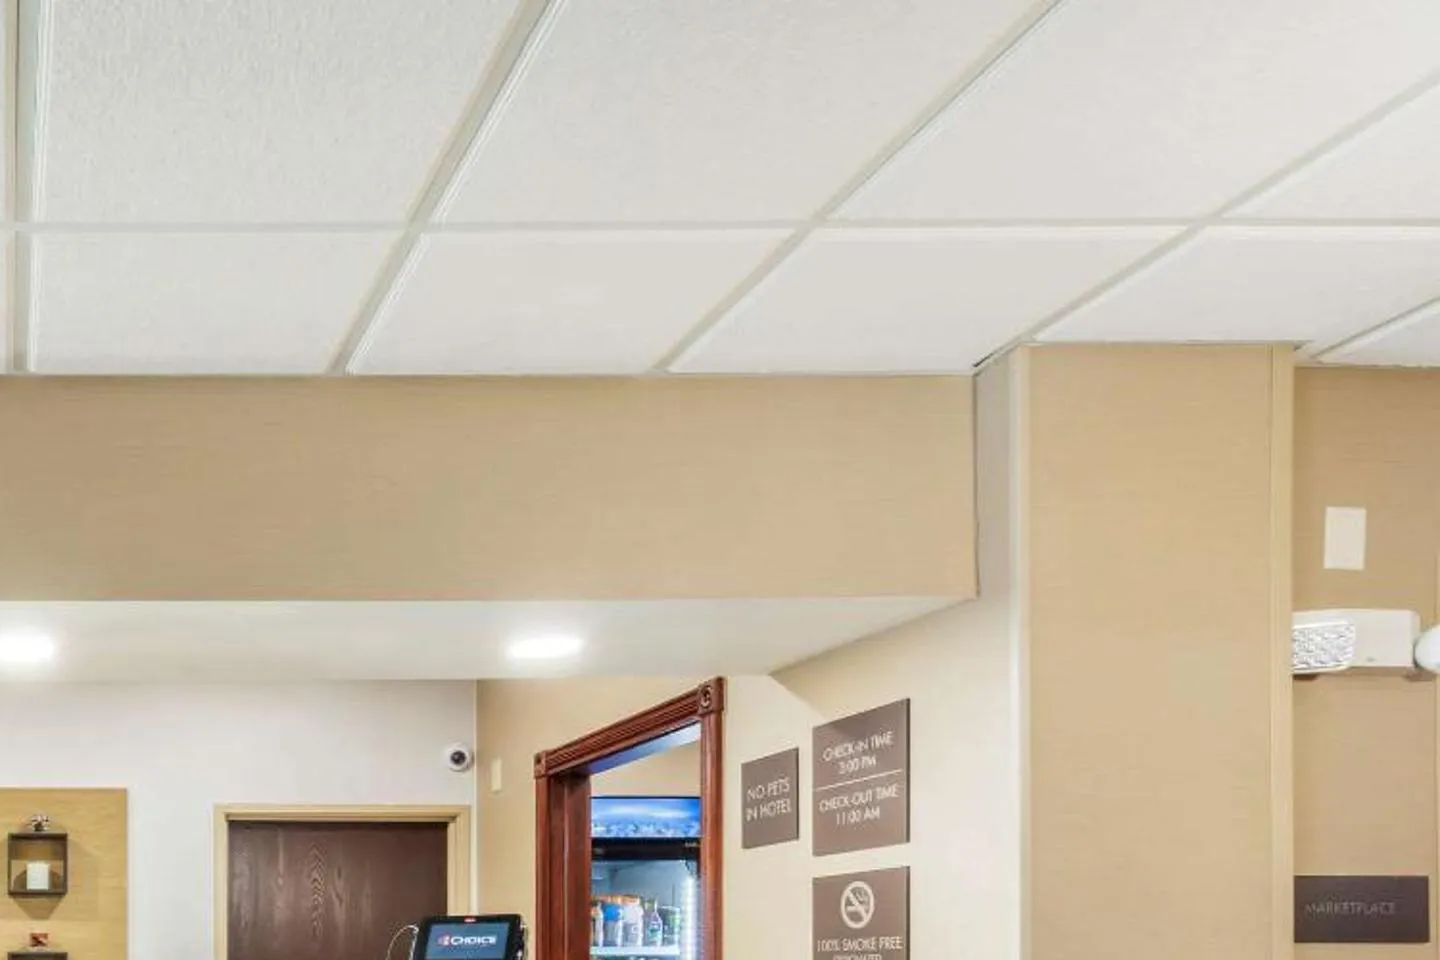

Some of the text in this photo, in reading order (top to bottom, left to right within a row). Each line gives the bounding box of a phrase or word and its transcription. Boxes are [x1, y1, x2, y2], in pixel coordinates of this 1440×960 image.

[870, 731, 894, 750] TIME
[861, 755, 877, 769] PM
[747, 777, 790, 803] NO PETS
[875, 783, 900, 800] TIME
[746, 798, 791, 822] IN HOTEL
[863, 806, 880, 821] AM
[1305, 901, 1396, 915] MARKETPLACE
[451, 935, 497, 946] CHOICE
[817, 936, 903, 952] 100% SMOKE FREE
